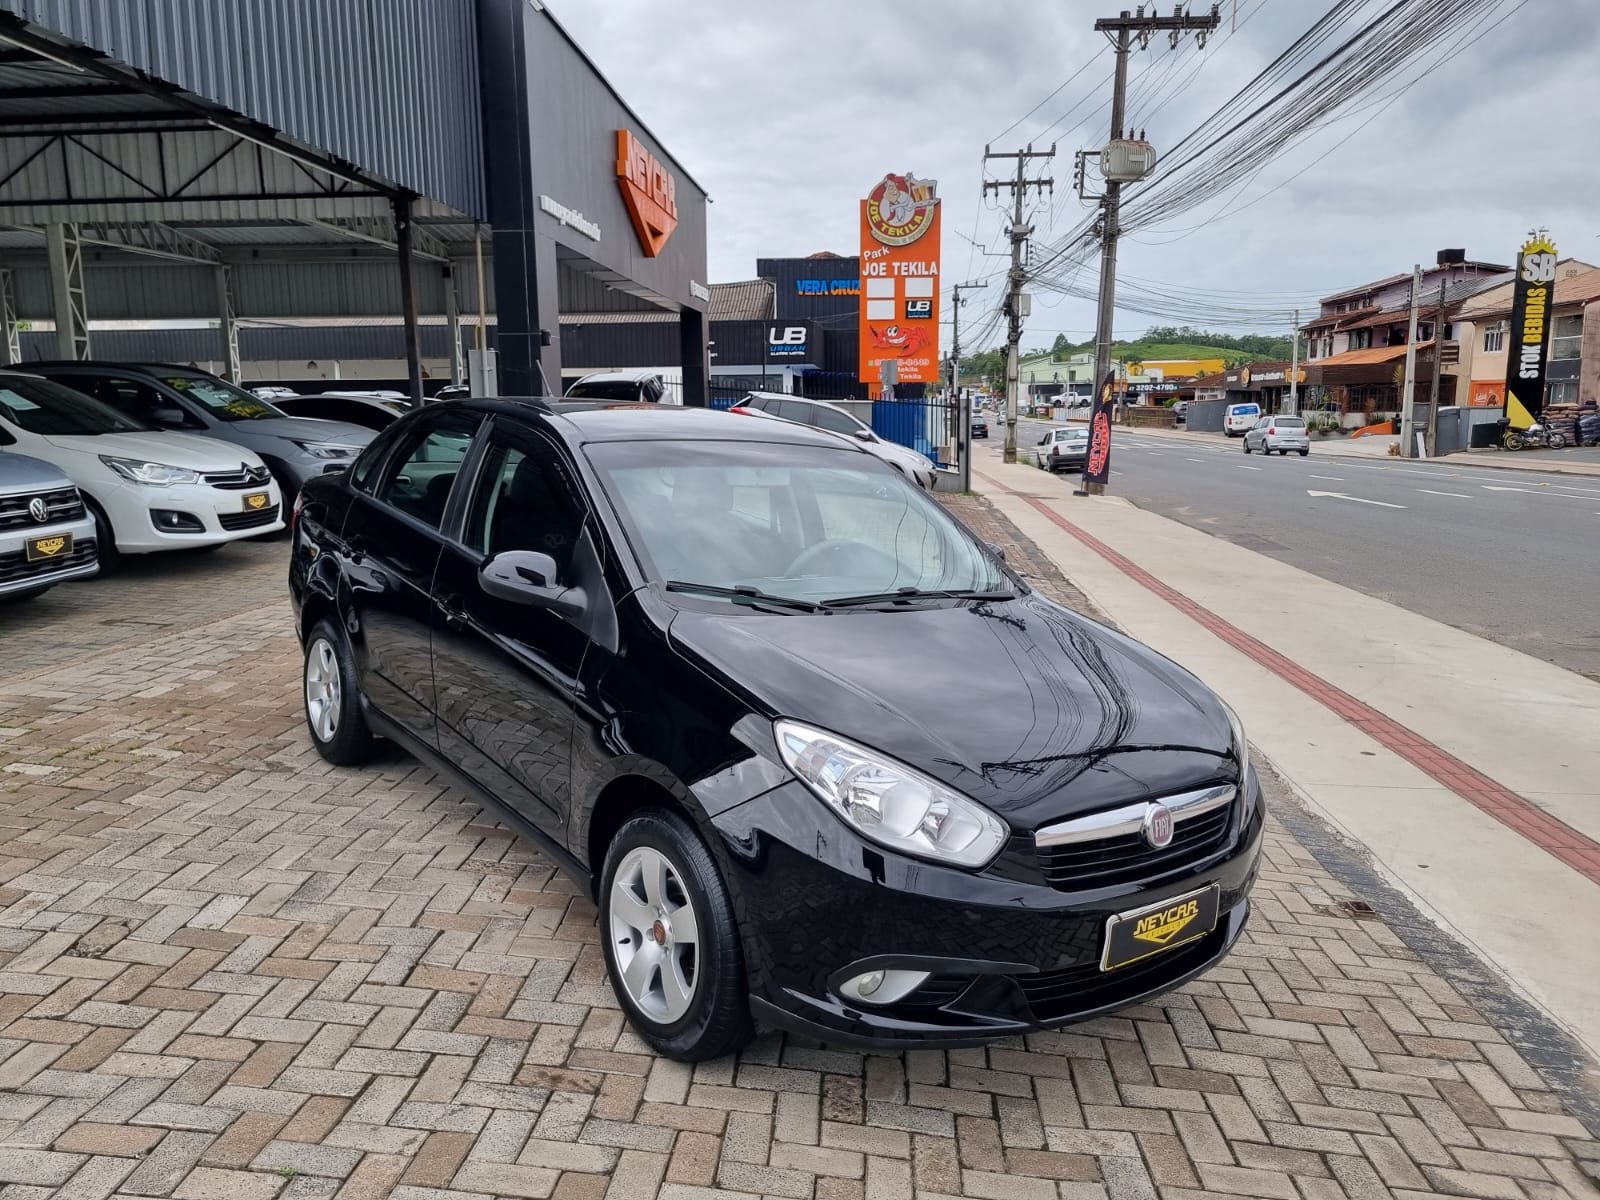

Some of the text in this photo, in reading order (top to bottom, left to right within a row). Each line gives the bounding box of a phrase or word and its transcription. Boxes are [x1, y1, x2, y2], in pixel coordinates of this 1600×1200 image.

[617, 129, 677, 221] NEYCAR
[870, 200, 881, 223] JOE
[880, 215, 923, 236] TEKILA
[863, 246, 890, 260] Park
[862, 261, 938, 276] JOE TEKILA
[1521, 253, 1556, 282] SB
[796, 279, 828, 296] VERA
[1519, 287, 1547, 379] STOK BEBIDAS
[36, 537, 65, 549] NEYCAR
[1154, 816, 1169, 838] FIAT
[1133, 900, 1199, 936] NEYCAR
